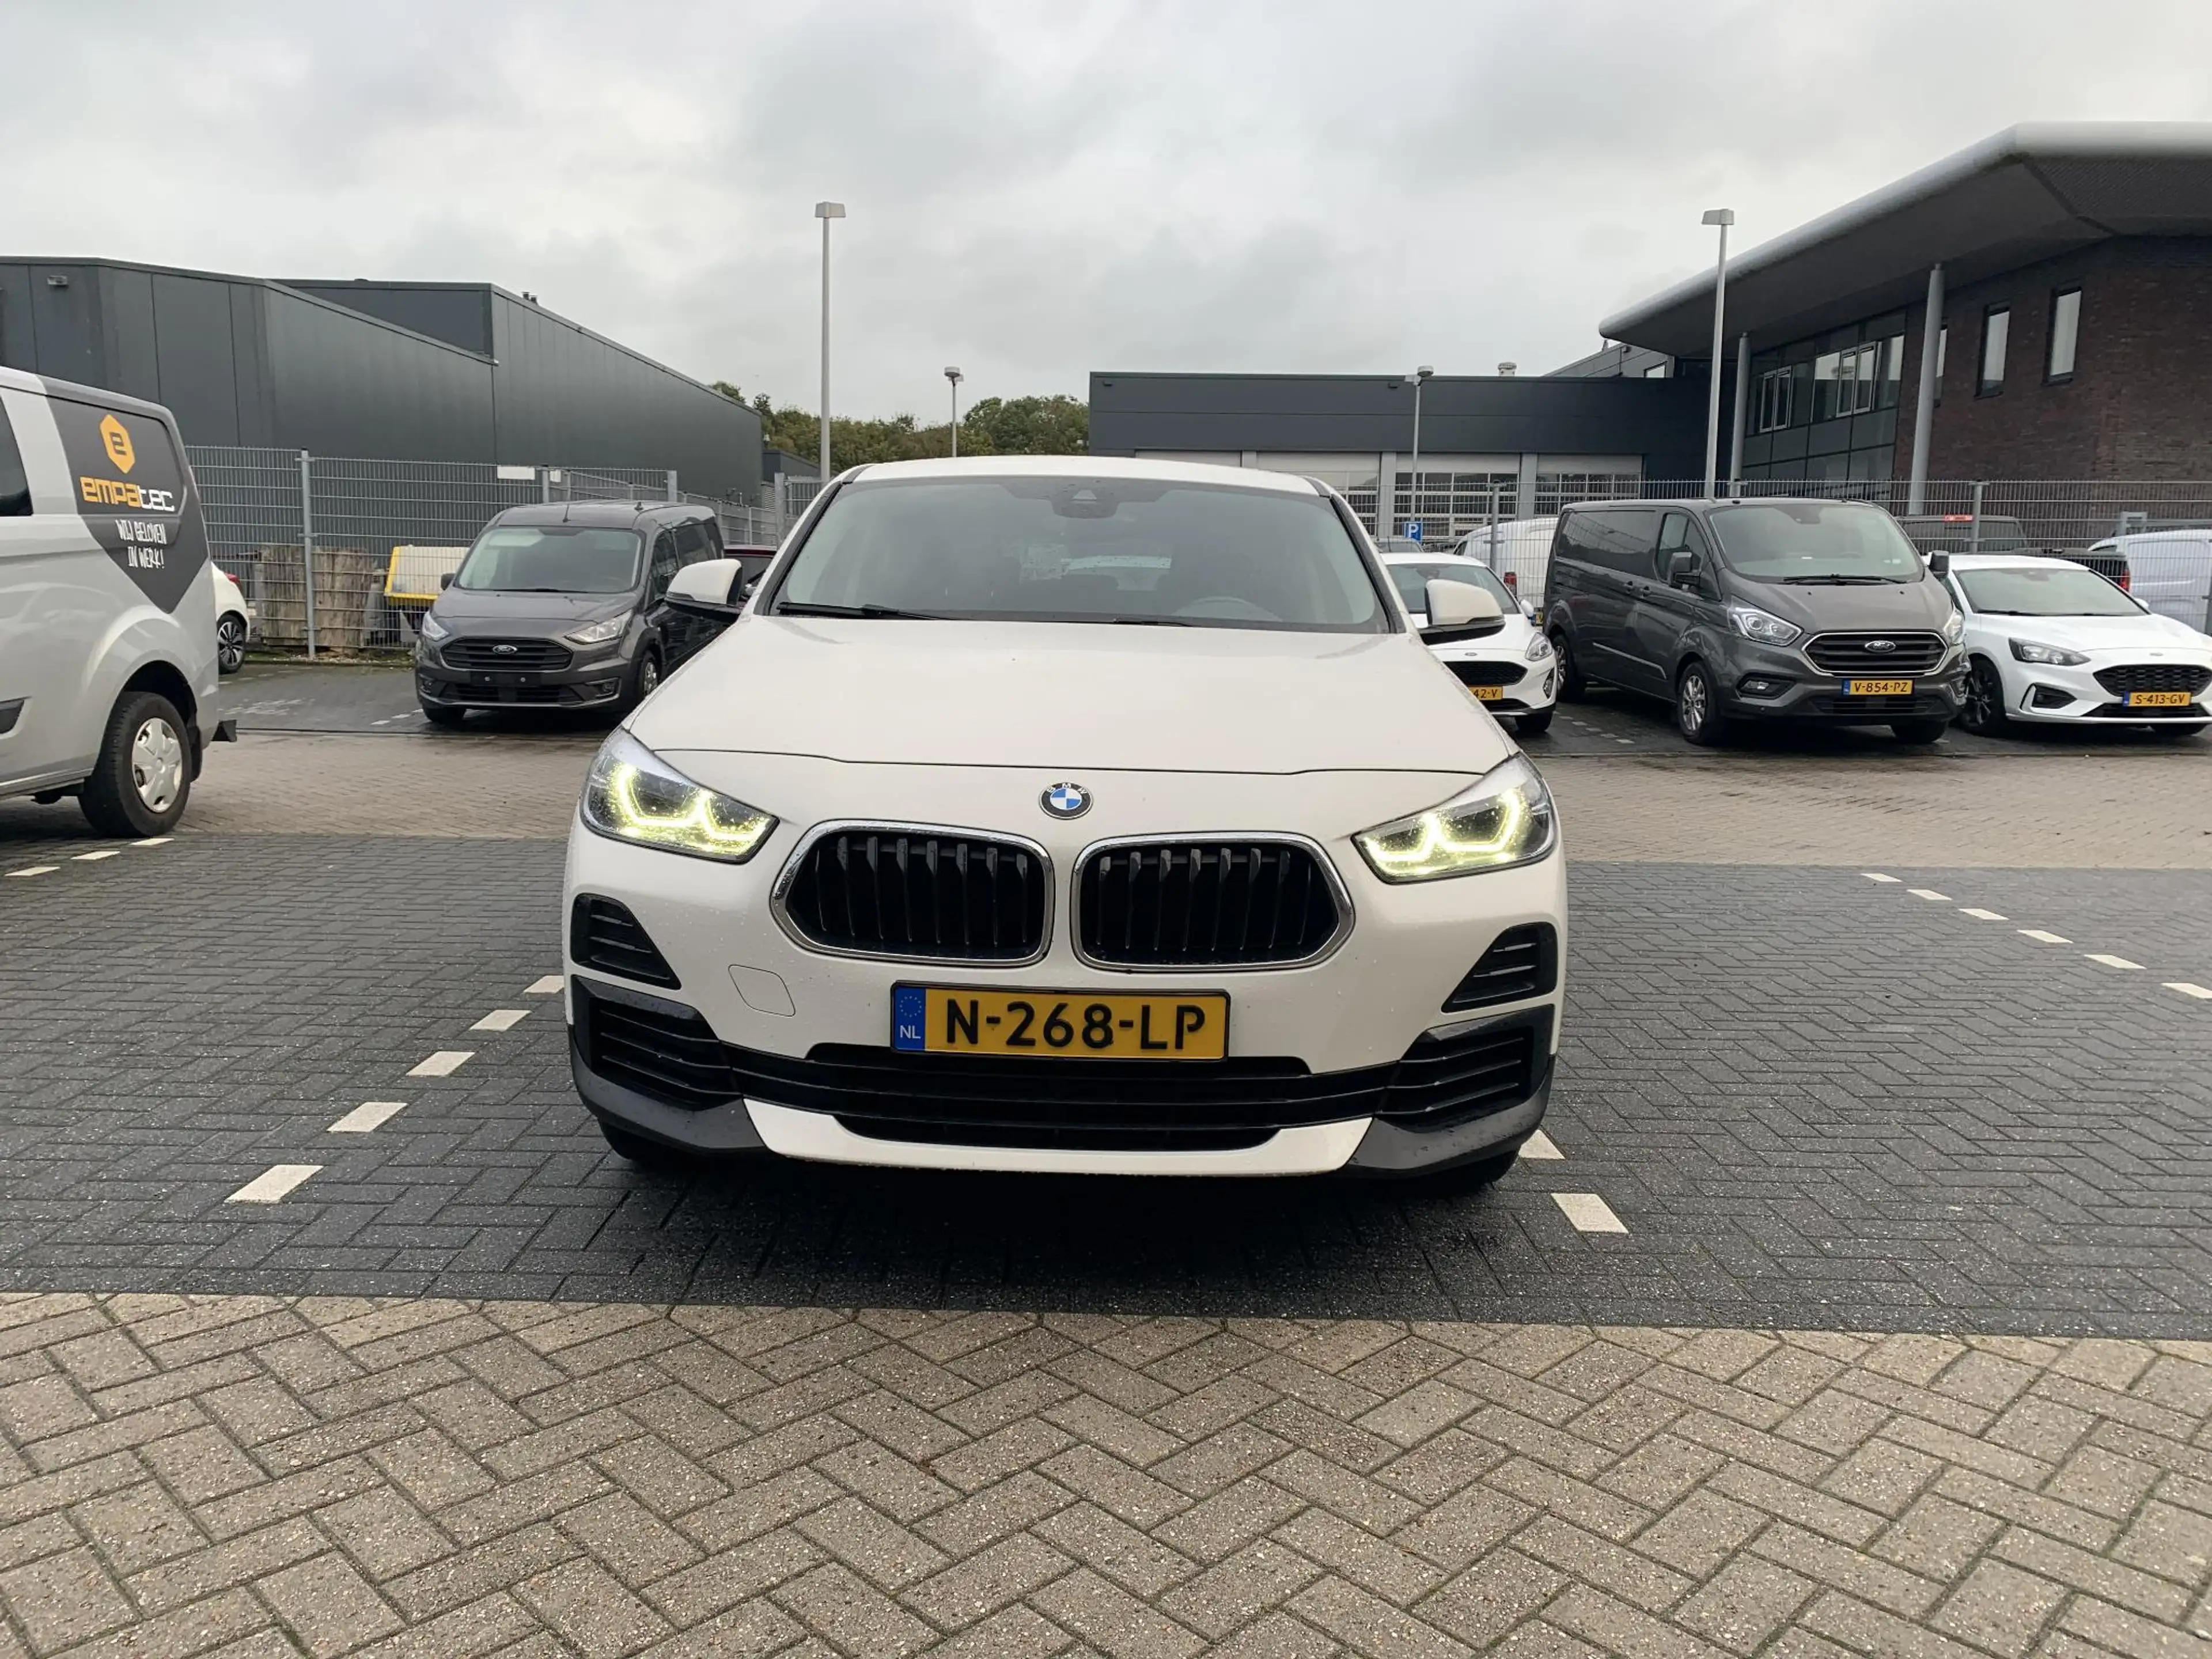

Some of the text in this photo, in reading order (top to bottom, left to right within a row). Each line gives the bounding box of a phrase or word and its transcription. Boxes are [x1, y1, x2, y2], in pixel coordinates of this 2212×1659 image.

[80, 476, 175, 512] empatec
[115, 519, 166, 545] WIJ GELOVEN
[1408, 524, 1419, 537] P
[127, 546, 165, 569] IN WERK!
[1854, 682, 1908, 692] V-854-PZ
[2135, 694, 2185, 704] S-413-GV
[900, 1025, 921, 1039] NL
[946, 998, 1206, 1051] N-268-LP
